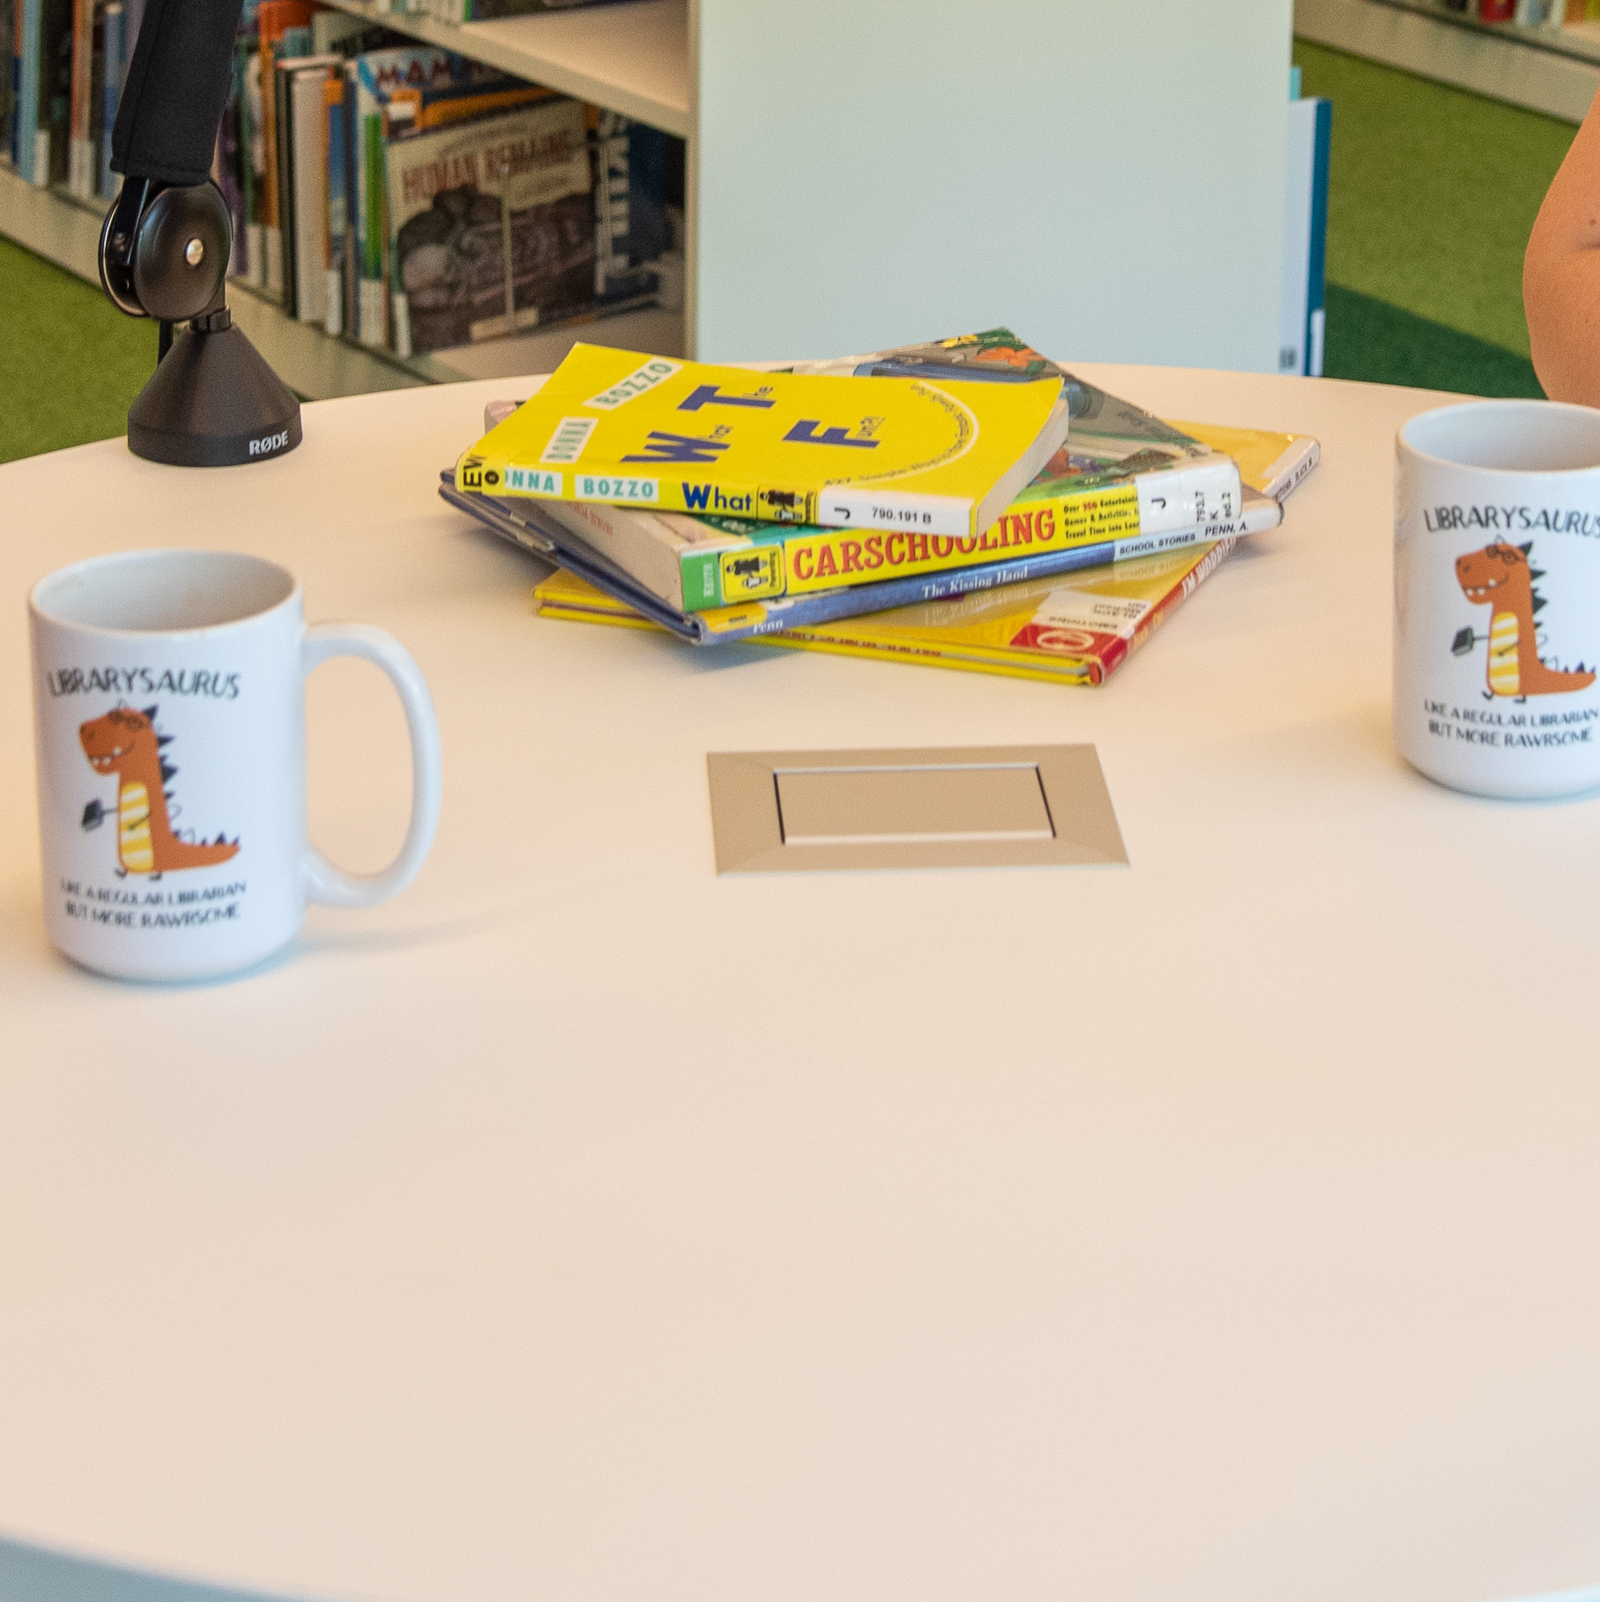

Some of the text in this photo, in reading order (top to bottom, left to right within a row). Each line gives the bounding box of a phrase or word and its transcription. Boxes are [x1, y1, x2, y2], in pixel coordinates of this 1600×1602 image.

[592, 361, 674, 407] BOZZO
[248, 429, 290, 456] RØDE
[583, 478, 655, 499] BOZZO
[681, 480, 753, 512] What
[833, 506, 851, 520] J
[871, 506, 919, 524] 790.191
[922, 512, 933, 525] B
[1063, 502, 1081, 514] Over
[1151, 497, 1167, 510] J
[793, 506, 1057, 581] CARSCHOOLING
[1064, 527, 1087, 540] Travel
[1088, 525, 1107, 538] Time
[1108, 523, 1122, 534] into
[921, 583, 948, 599] The
[950, 570, 993, 595] Kissing
[996, 564, 1029, 585] Hand
[1119, 538, 1157, 556] SCHOOL
[1158, 531, 1197, 548] STORIES
[47, 667, 242, 700] LIBRARYSAURUS
[1424, 698, 1448, 718] LIKE
[1462, 705, 1528, 727] REGULAR
[1530, 706, 1599, 727] LIBRARIAN
[1428, 719, 1594, 749] BUT MORE RAWRSOME
[97, 883, 165, 907] REGULAR
[167, 878, 247, 907] LIBRARIAN
[65, 901, 242, 929] BUT MORE RAWRSOME
